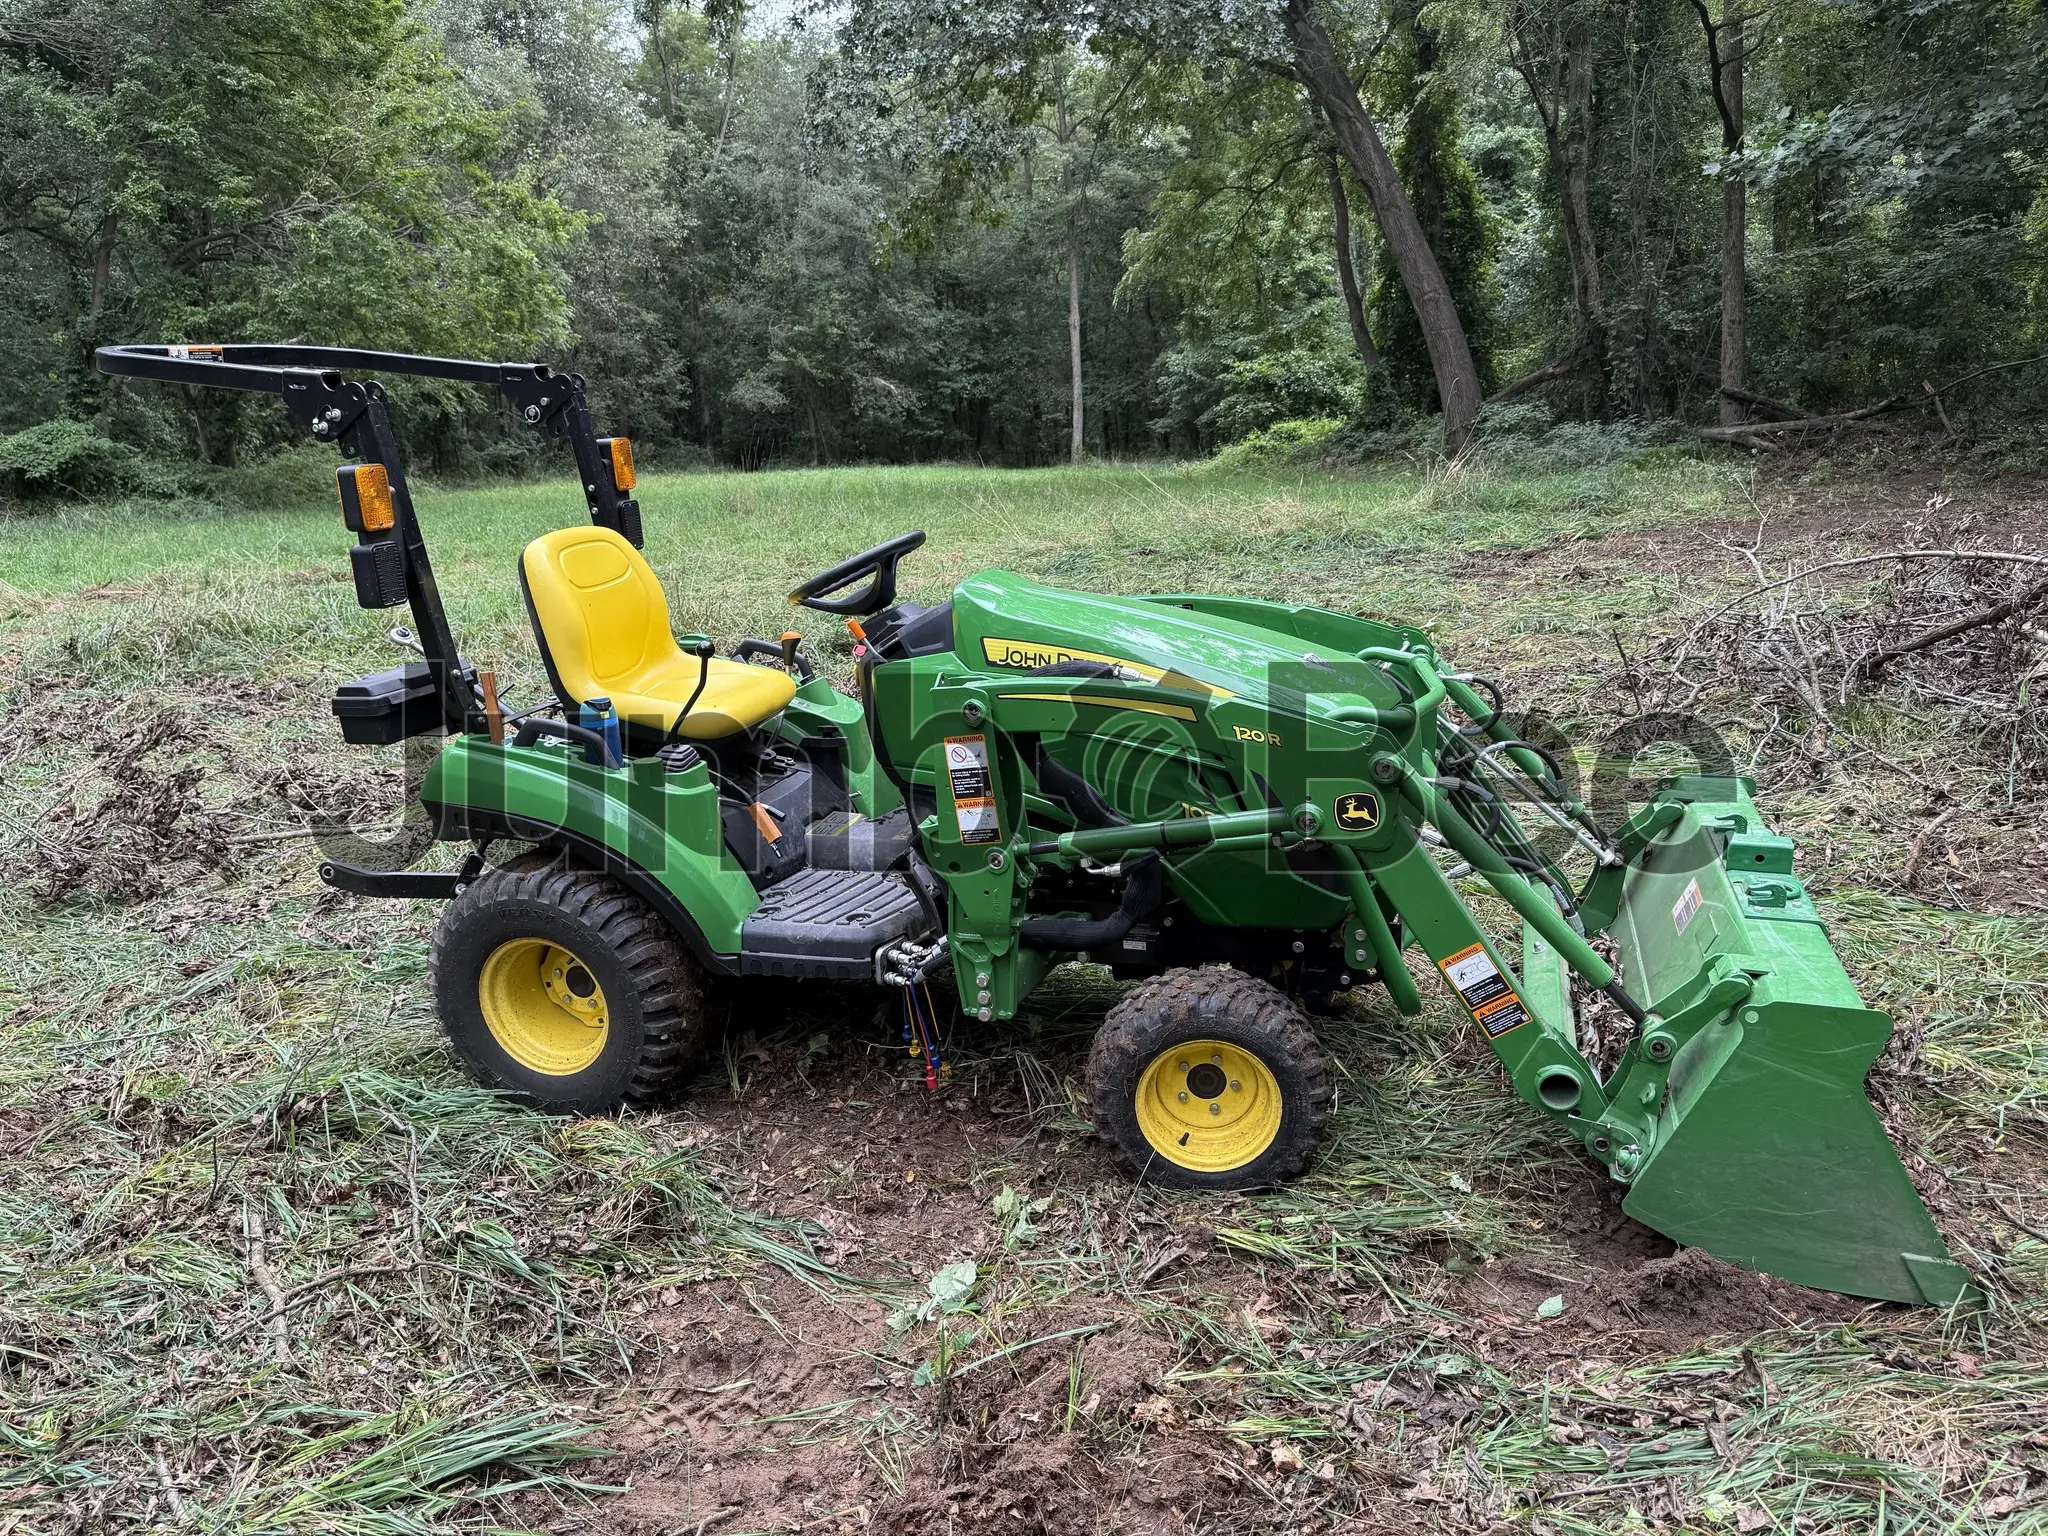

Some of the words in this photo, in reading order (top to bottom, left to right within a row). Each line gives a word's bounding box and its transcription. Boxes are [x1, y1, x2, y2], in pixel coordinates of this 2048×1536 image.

[999, 647, 1051, 666] JOHN
[952, 735, 984, 744] WARNING
[962, 800, 994, 808] WARNING
[1450, 946, 1479, 963] WARNING
[1486, 998, 1514, 1012] WARNING
